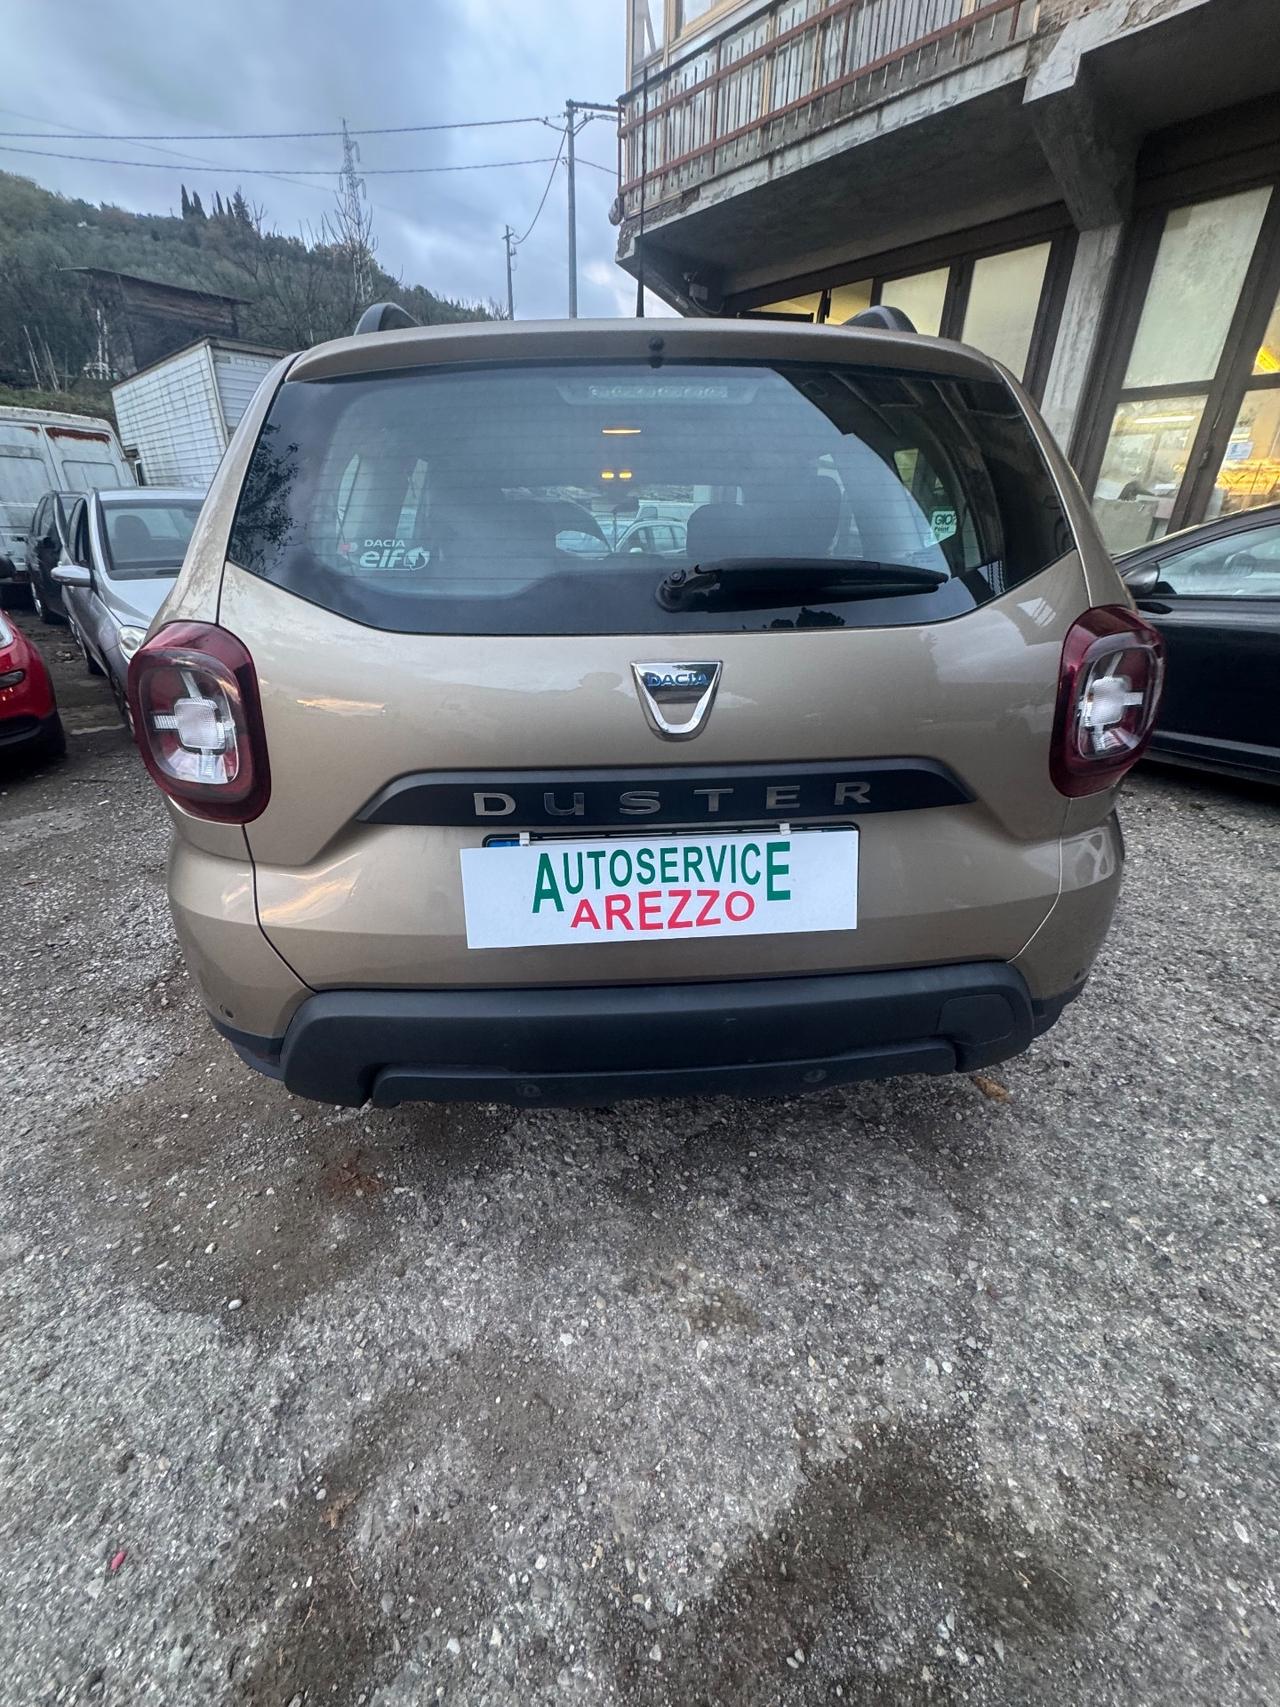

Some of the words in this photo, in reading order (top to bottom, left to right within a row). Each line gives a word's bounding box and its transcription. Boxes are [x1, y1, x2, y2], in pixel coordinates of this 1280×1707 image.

[364, 539, 405, 547] DACIA
[360, 549, 405, 567] elf
[646, 673, 709, 687] DACIA
[473, 782, 871, 816] DUSTER
[532, 842, 791, 913] AUTOSERVICE
[570, 890, 755, 930] AREZZO
